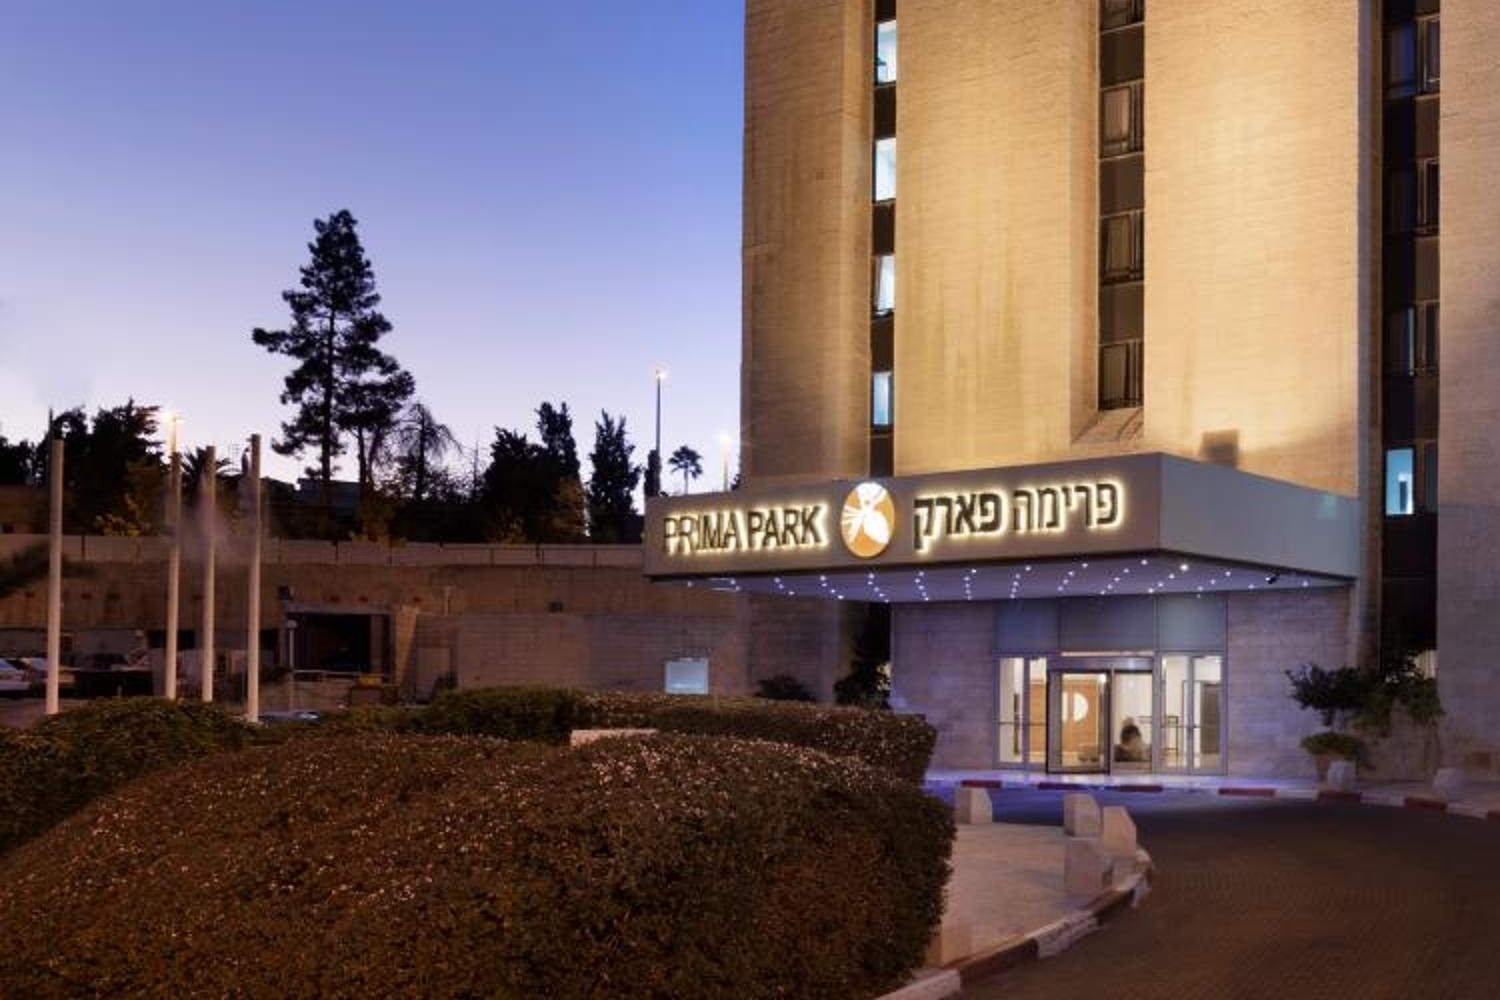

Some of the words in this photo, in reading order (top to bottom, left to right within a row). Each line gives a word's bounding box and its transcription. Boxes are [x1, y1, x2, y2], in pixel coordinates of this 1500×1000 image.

[663, 510, 741, 554] PRIMA
[747, 504, 824, 548] PARK
[912, 492, 1003, 550] פארק
[1012, 483, 1118, 531] פרימה
